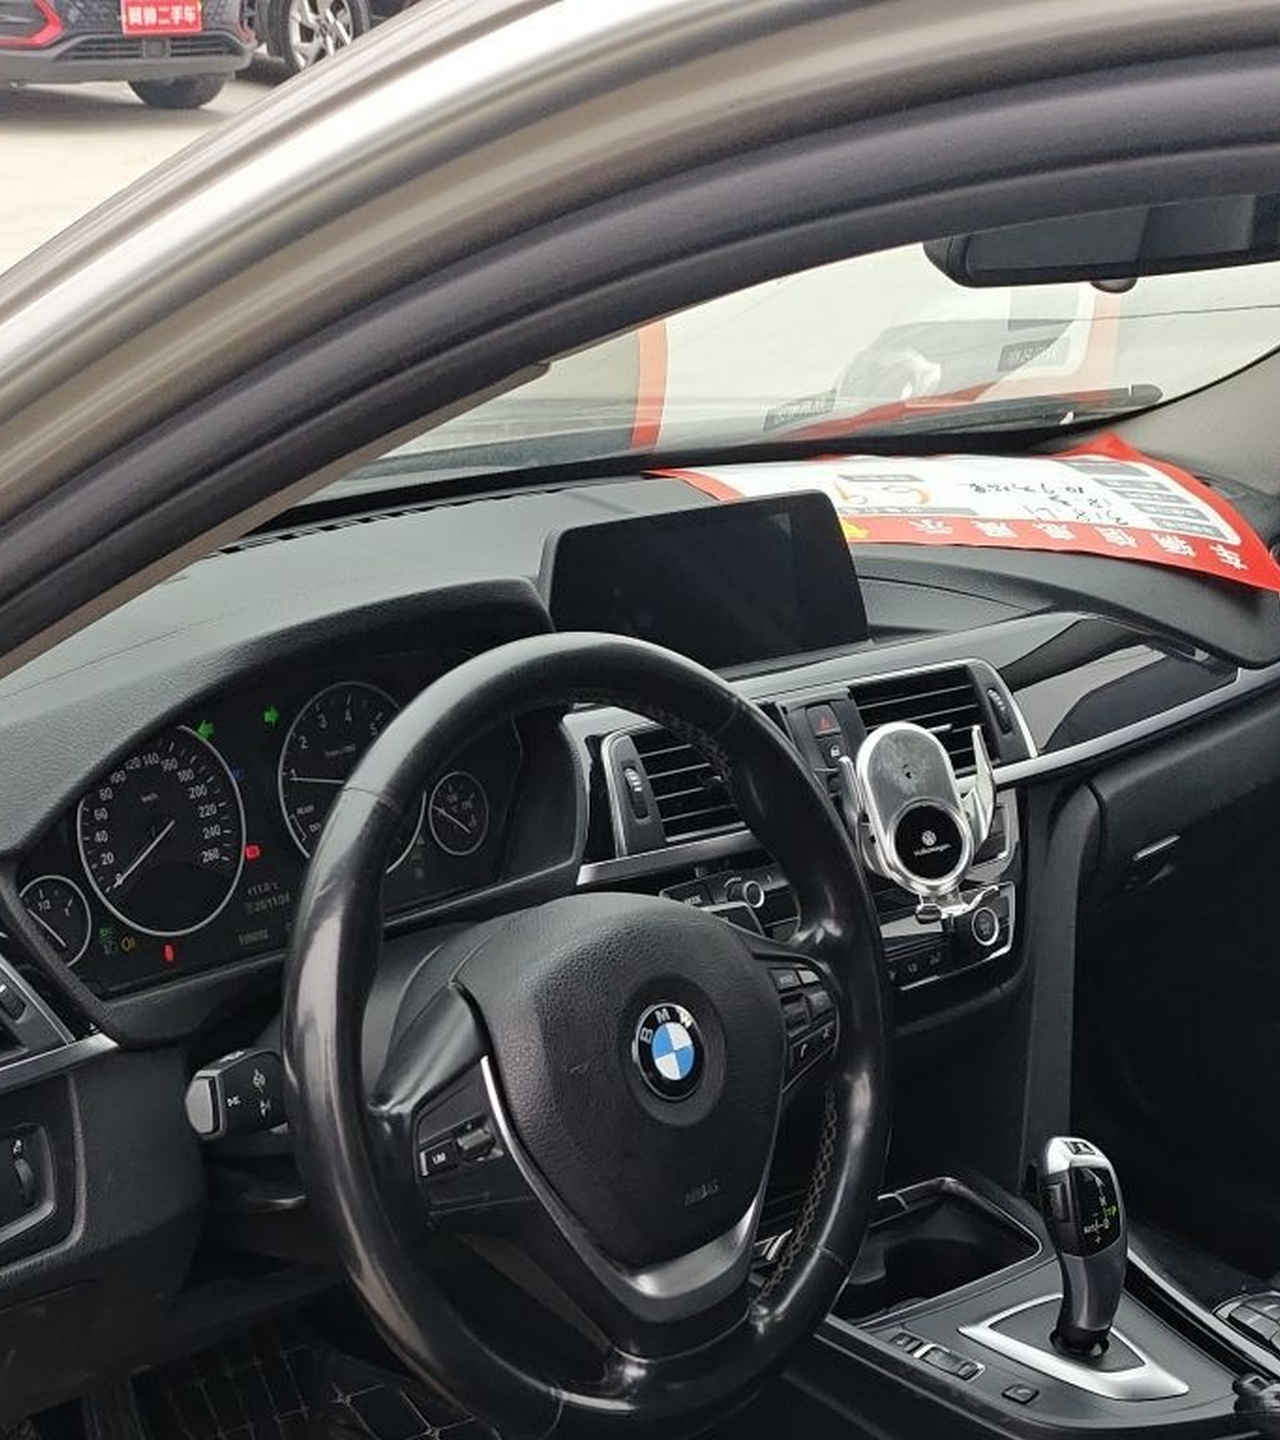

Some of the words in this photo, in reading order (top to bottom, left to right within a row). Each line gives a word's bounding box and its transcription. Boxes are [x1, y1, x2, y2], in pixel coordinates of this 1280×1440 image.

[298, 736, 308, 749] 2
[188, 785, 208, 799] 200
[198, 804, 217, 819] 220
[94, 830, 109, 843] 40
[202, 824, 221, 840] 240
[100, 852, 114, 865] 20
[640, 1008, 693, 1044] BMW
